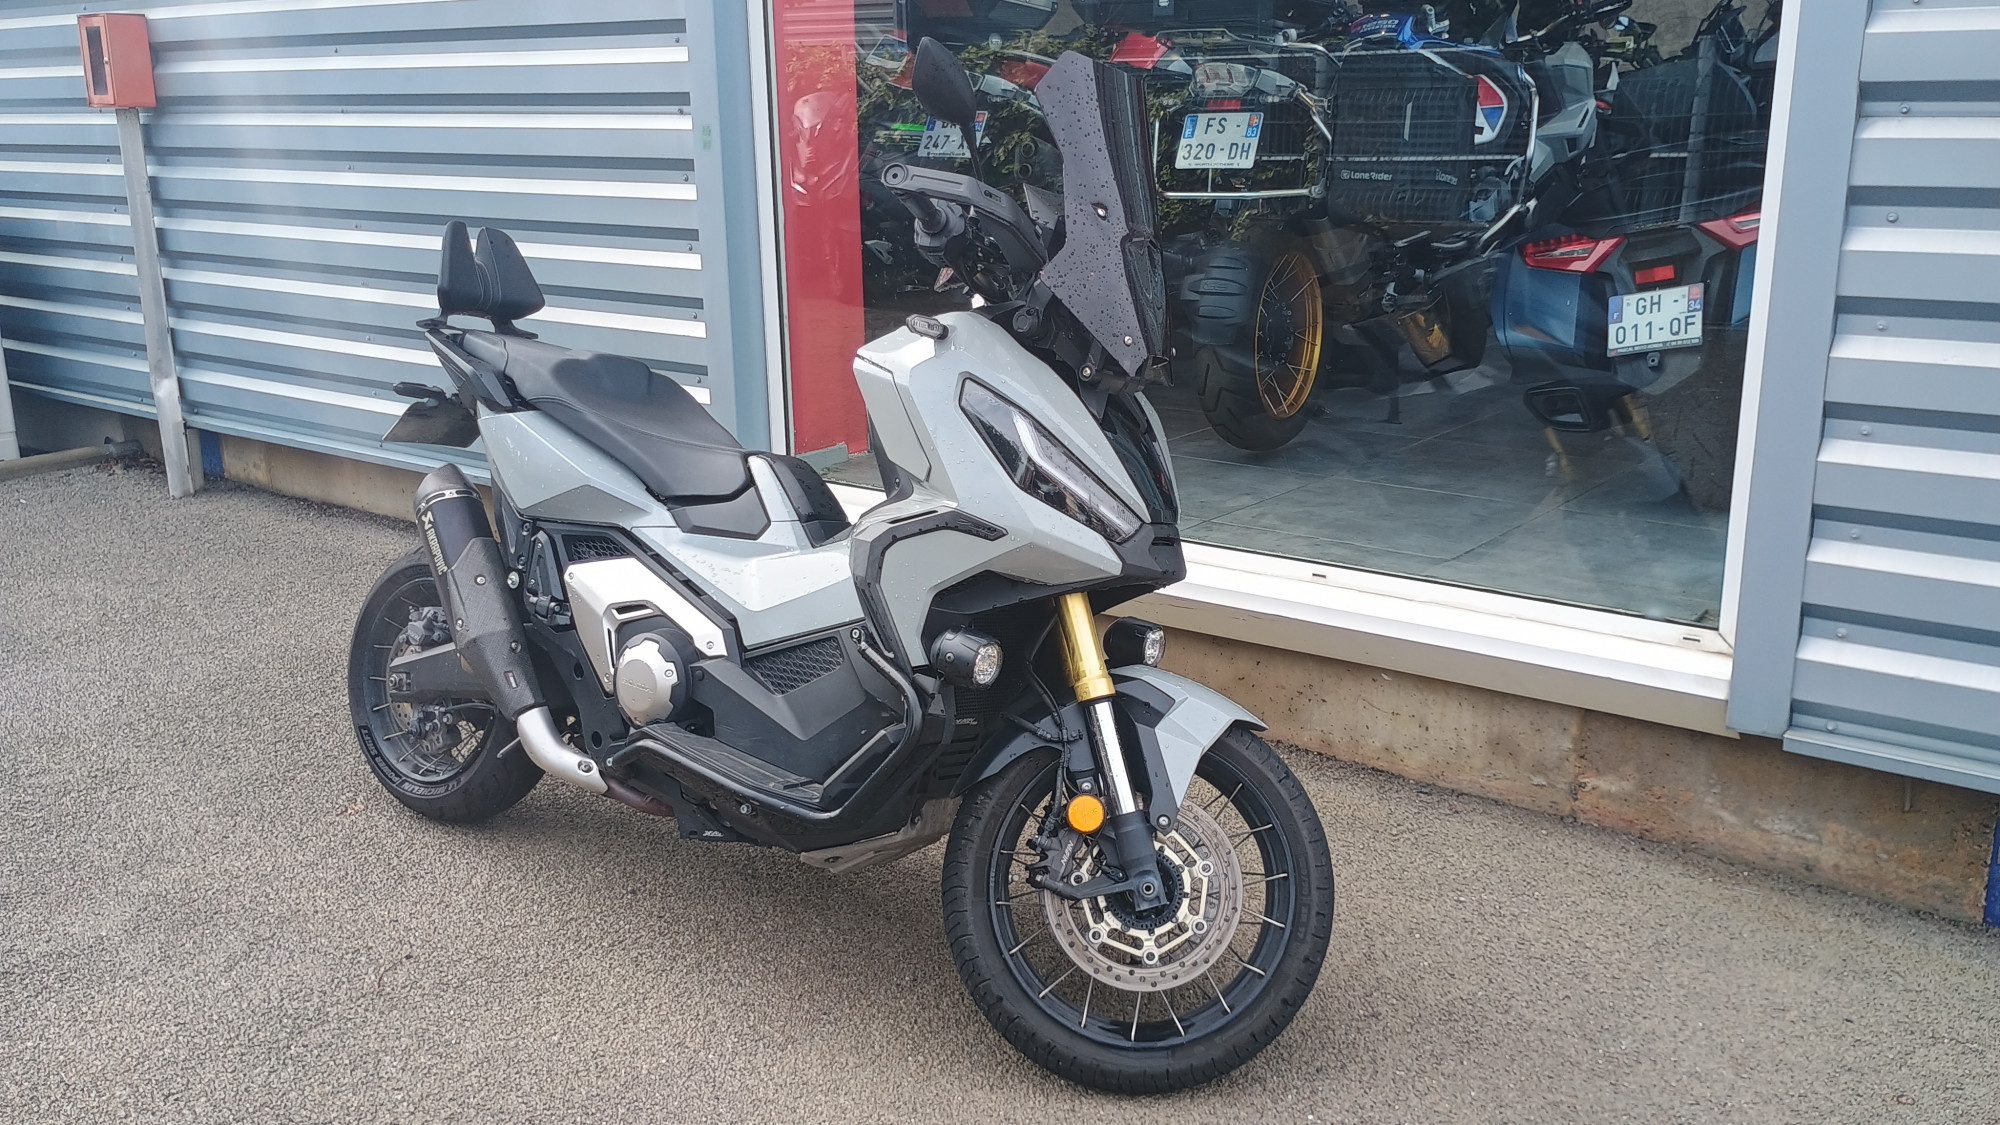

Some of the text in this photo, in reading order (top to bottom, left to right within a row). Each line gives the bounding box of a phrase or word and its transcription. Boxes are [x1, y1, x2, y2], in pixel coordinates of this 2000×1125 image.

[1204, 117, 1227, 135] FS
[1246, 127, 1257, 137] 83
[1182, 142, 1252, 161] 320-DH
[1635, 294, 1662, 316] GH
[1688, 299, 1701, 311] 34
[1615, 314, 1697, 345] 011-QF
[360, 728, 378, 757] SHIFT
[374, 755, 400, 784] POWER
[401, 780, 448, 796] MICHELIN
